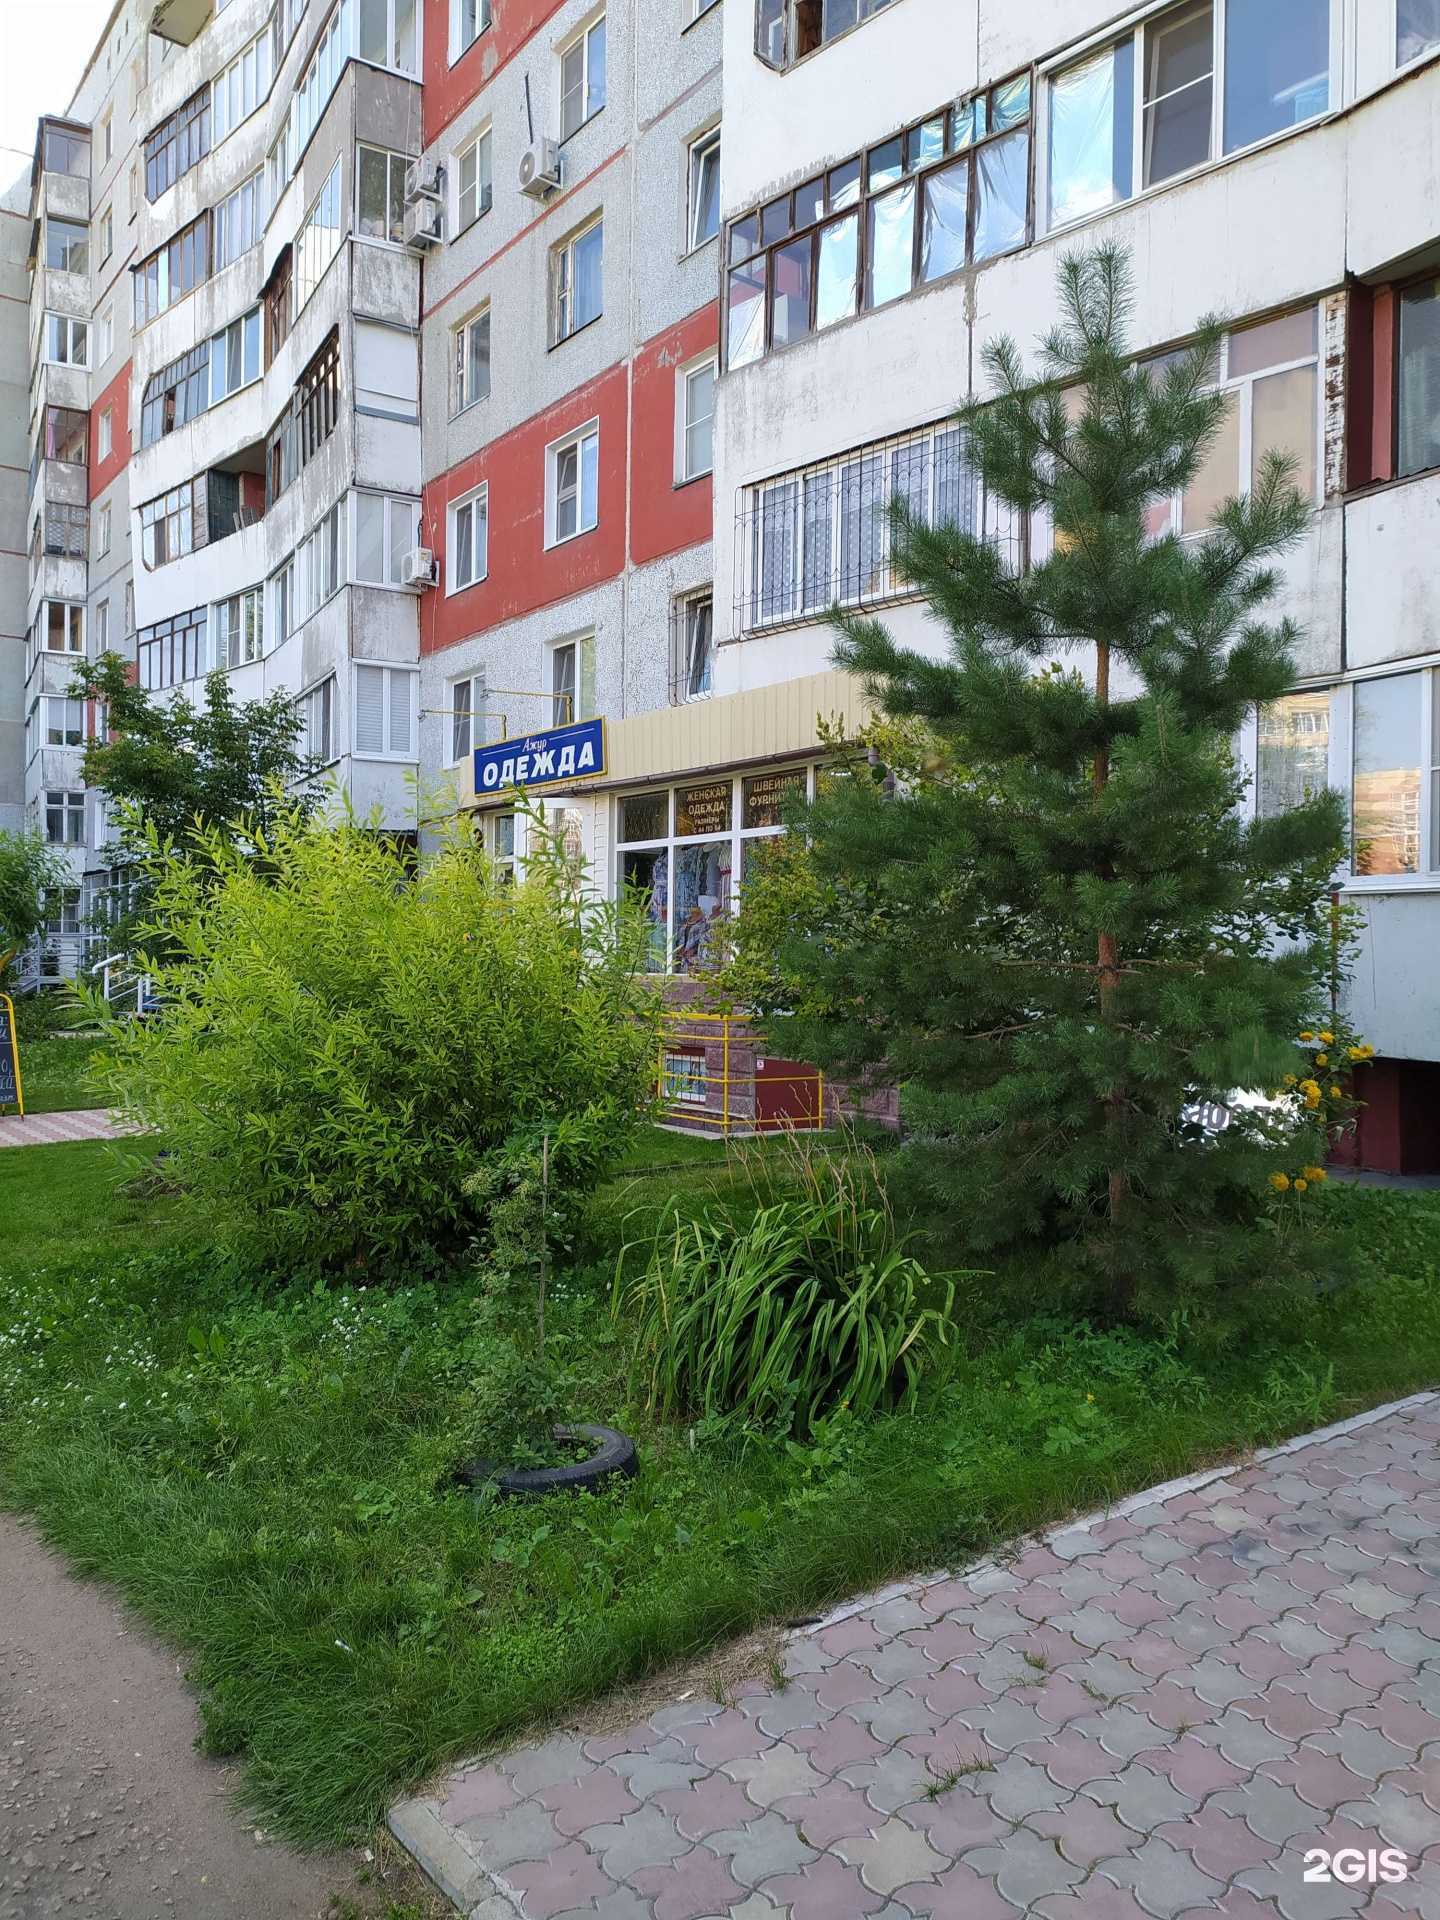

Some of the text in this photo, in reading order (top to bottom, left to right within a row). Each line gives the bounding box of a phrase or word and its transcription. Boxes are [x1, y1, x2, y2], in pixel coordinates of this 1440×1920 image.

[522, 738, 547, 753] Ажур
[483, 741, 595, 788] ОДЕЖДА
[686, 786, 727, 802] ЖЕНСКАЯ
[688, 800, 726, 816] ОДЕЖДА
